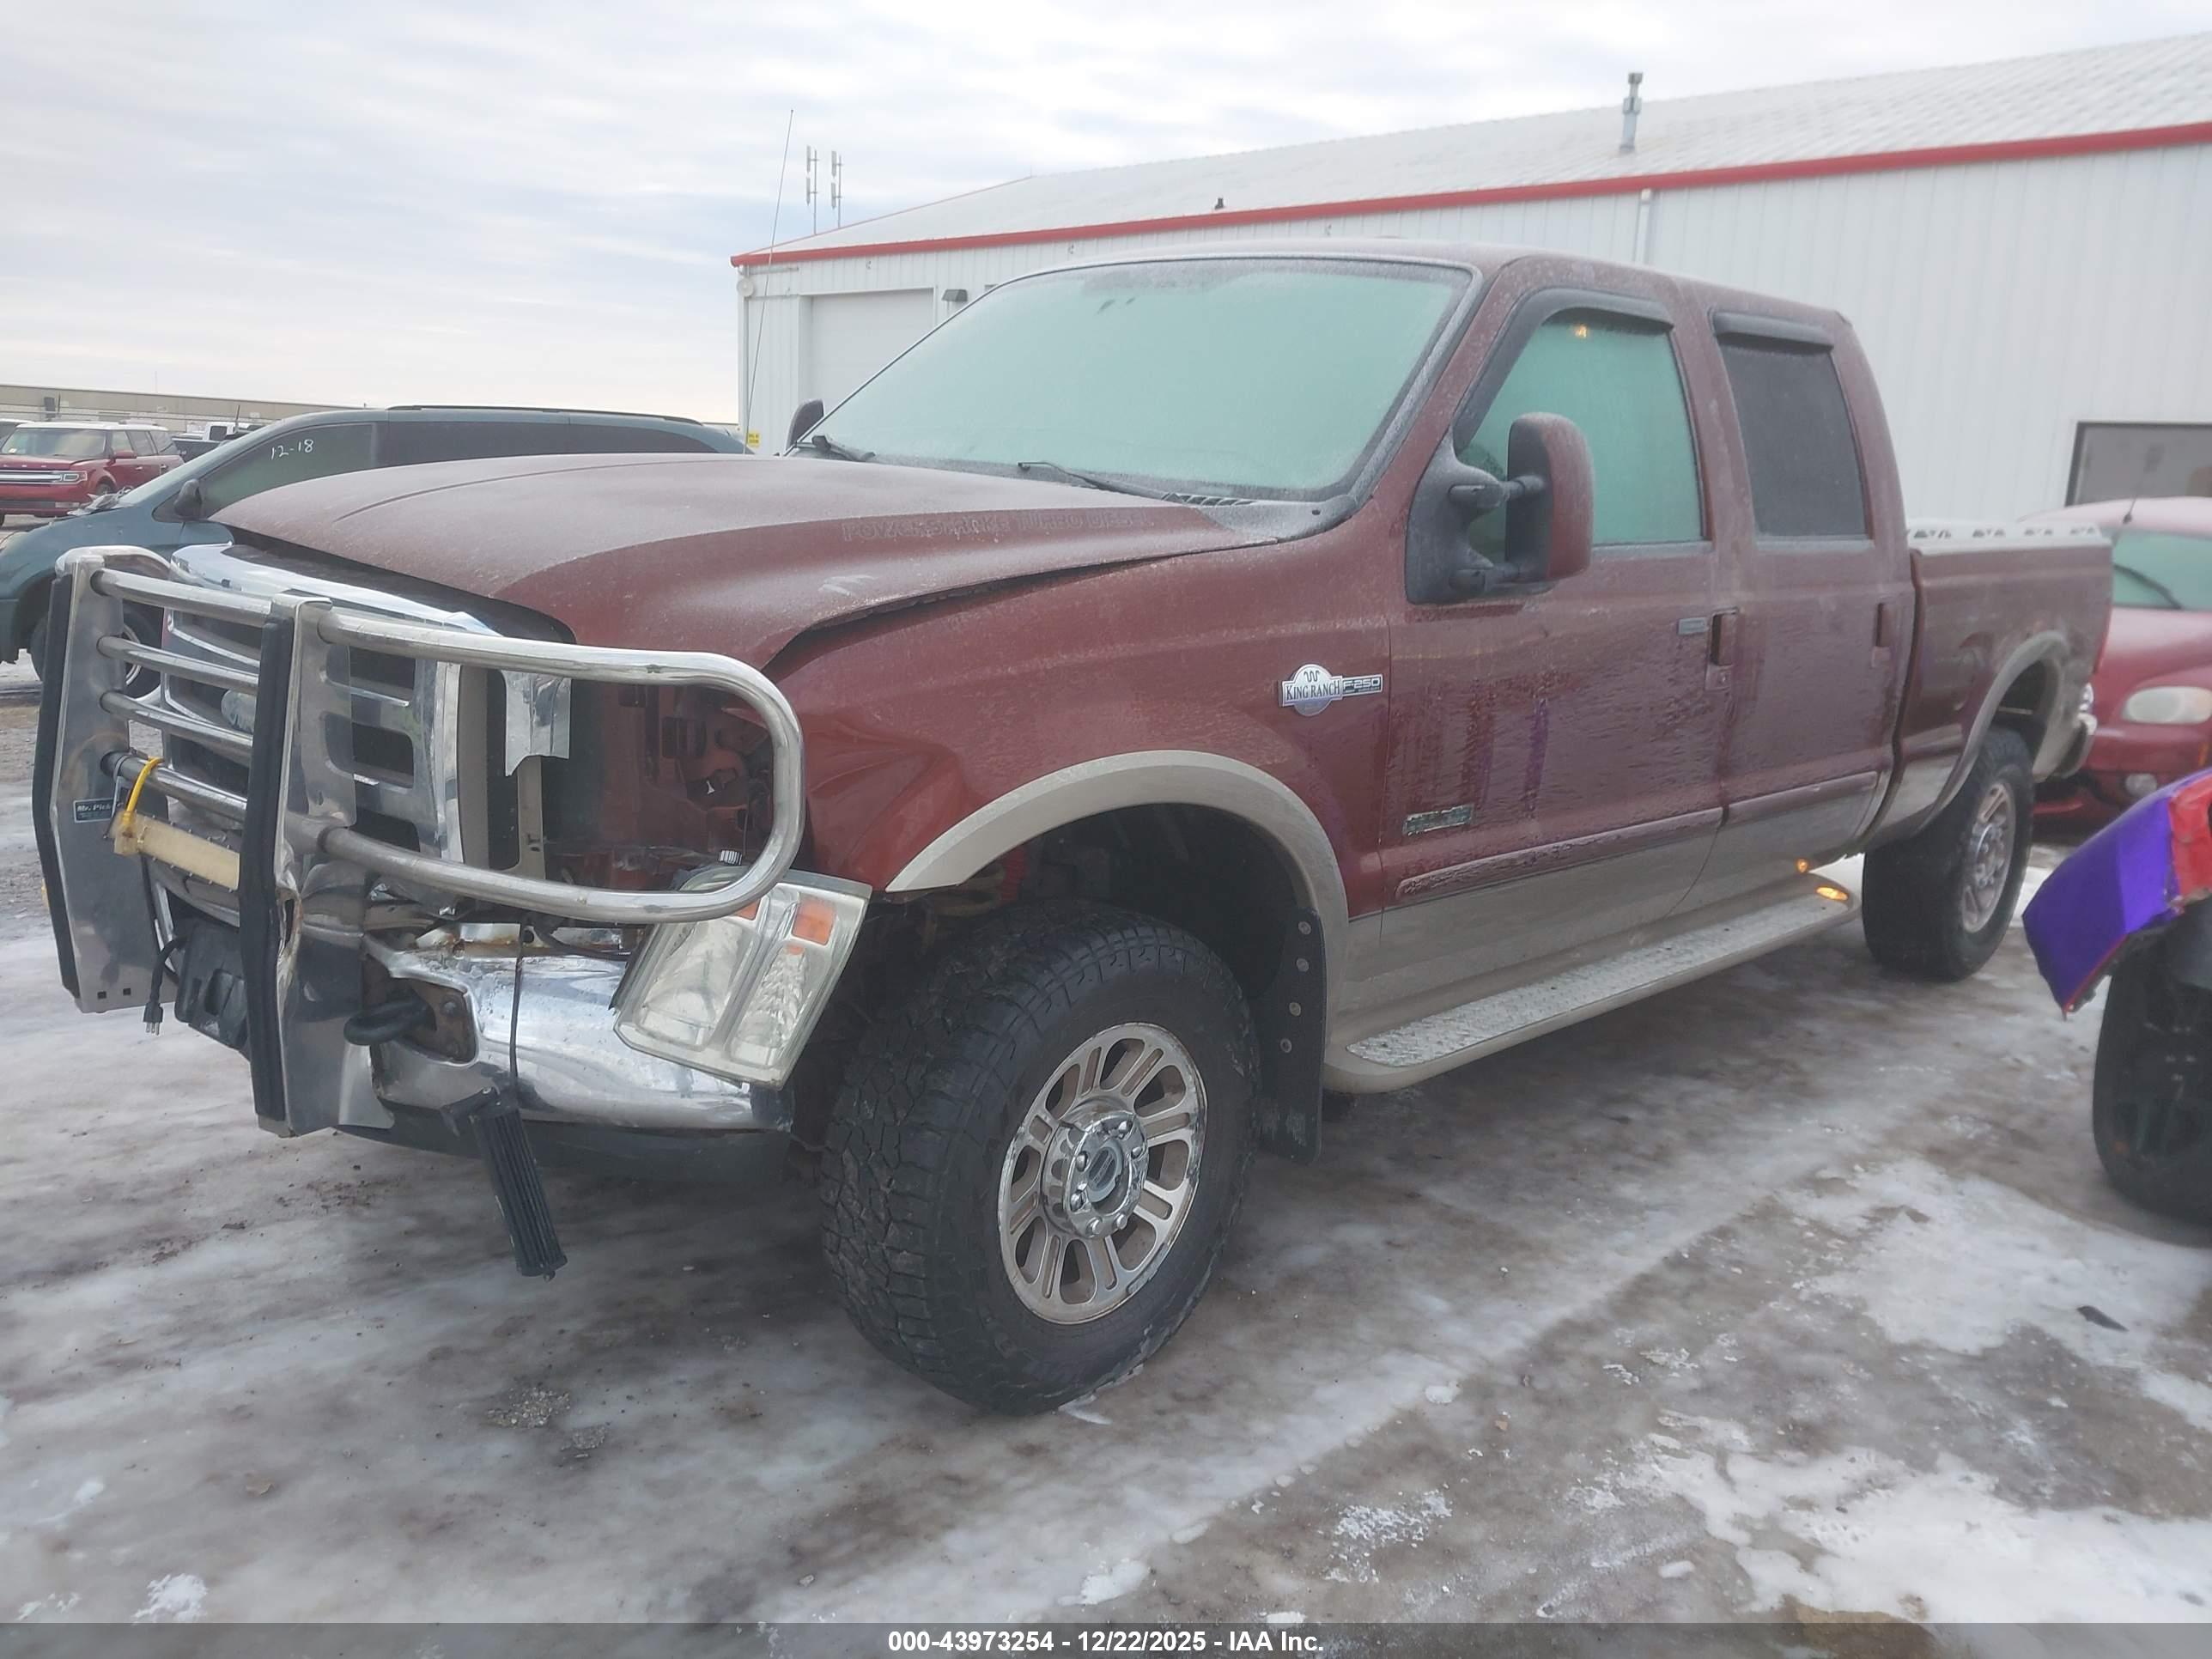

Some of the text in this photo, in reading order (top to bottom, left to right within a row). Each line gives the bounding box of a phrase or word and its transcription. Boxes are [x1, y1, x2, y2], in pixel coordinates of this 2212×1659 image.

[270, 439, 314, 460] 12-18
[1286, 680, 1340, 701] KING RANCH
